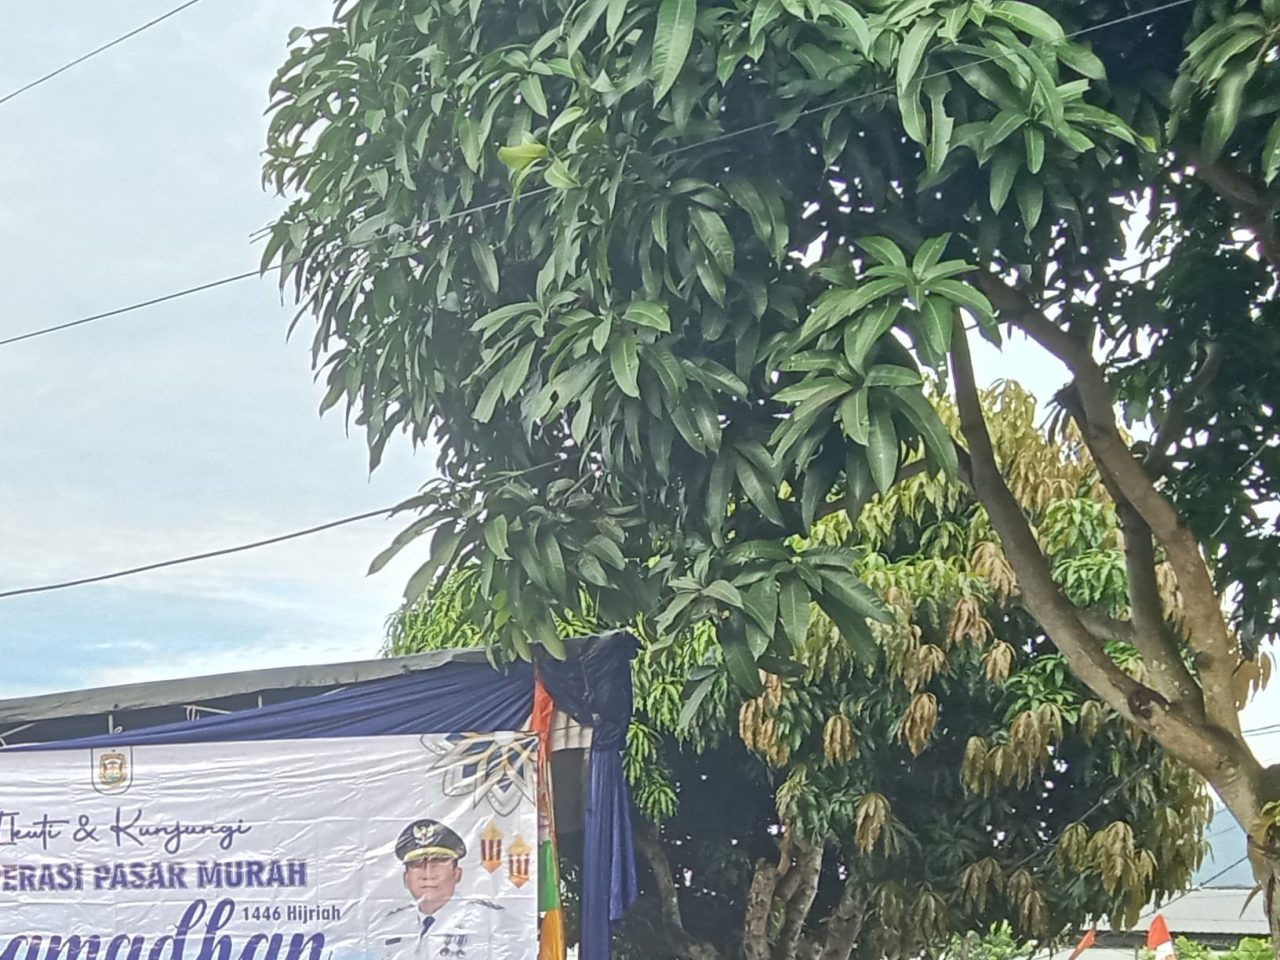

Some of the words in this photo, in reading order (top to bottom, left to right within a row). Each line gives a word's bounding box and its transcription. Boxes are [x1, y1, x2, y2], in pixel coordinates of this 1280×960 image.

[73, 814, 99, 842] &
[110, 807, 252, 854] Kunjungi
[94, 861, 187, 890] PASAR
[197, 859, 308, 888] MURAH
[242, 906, 281, 921] 1446
[287, 904, 341, 924] Hijriah
